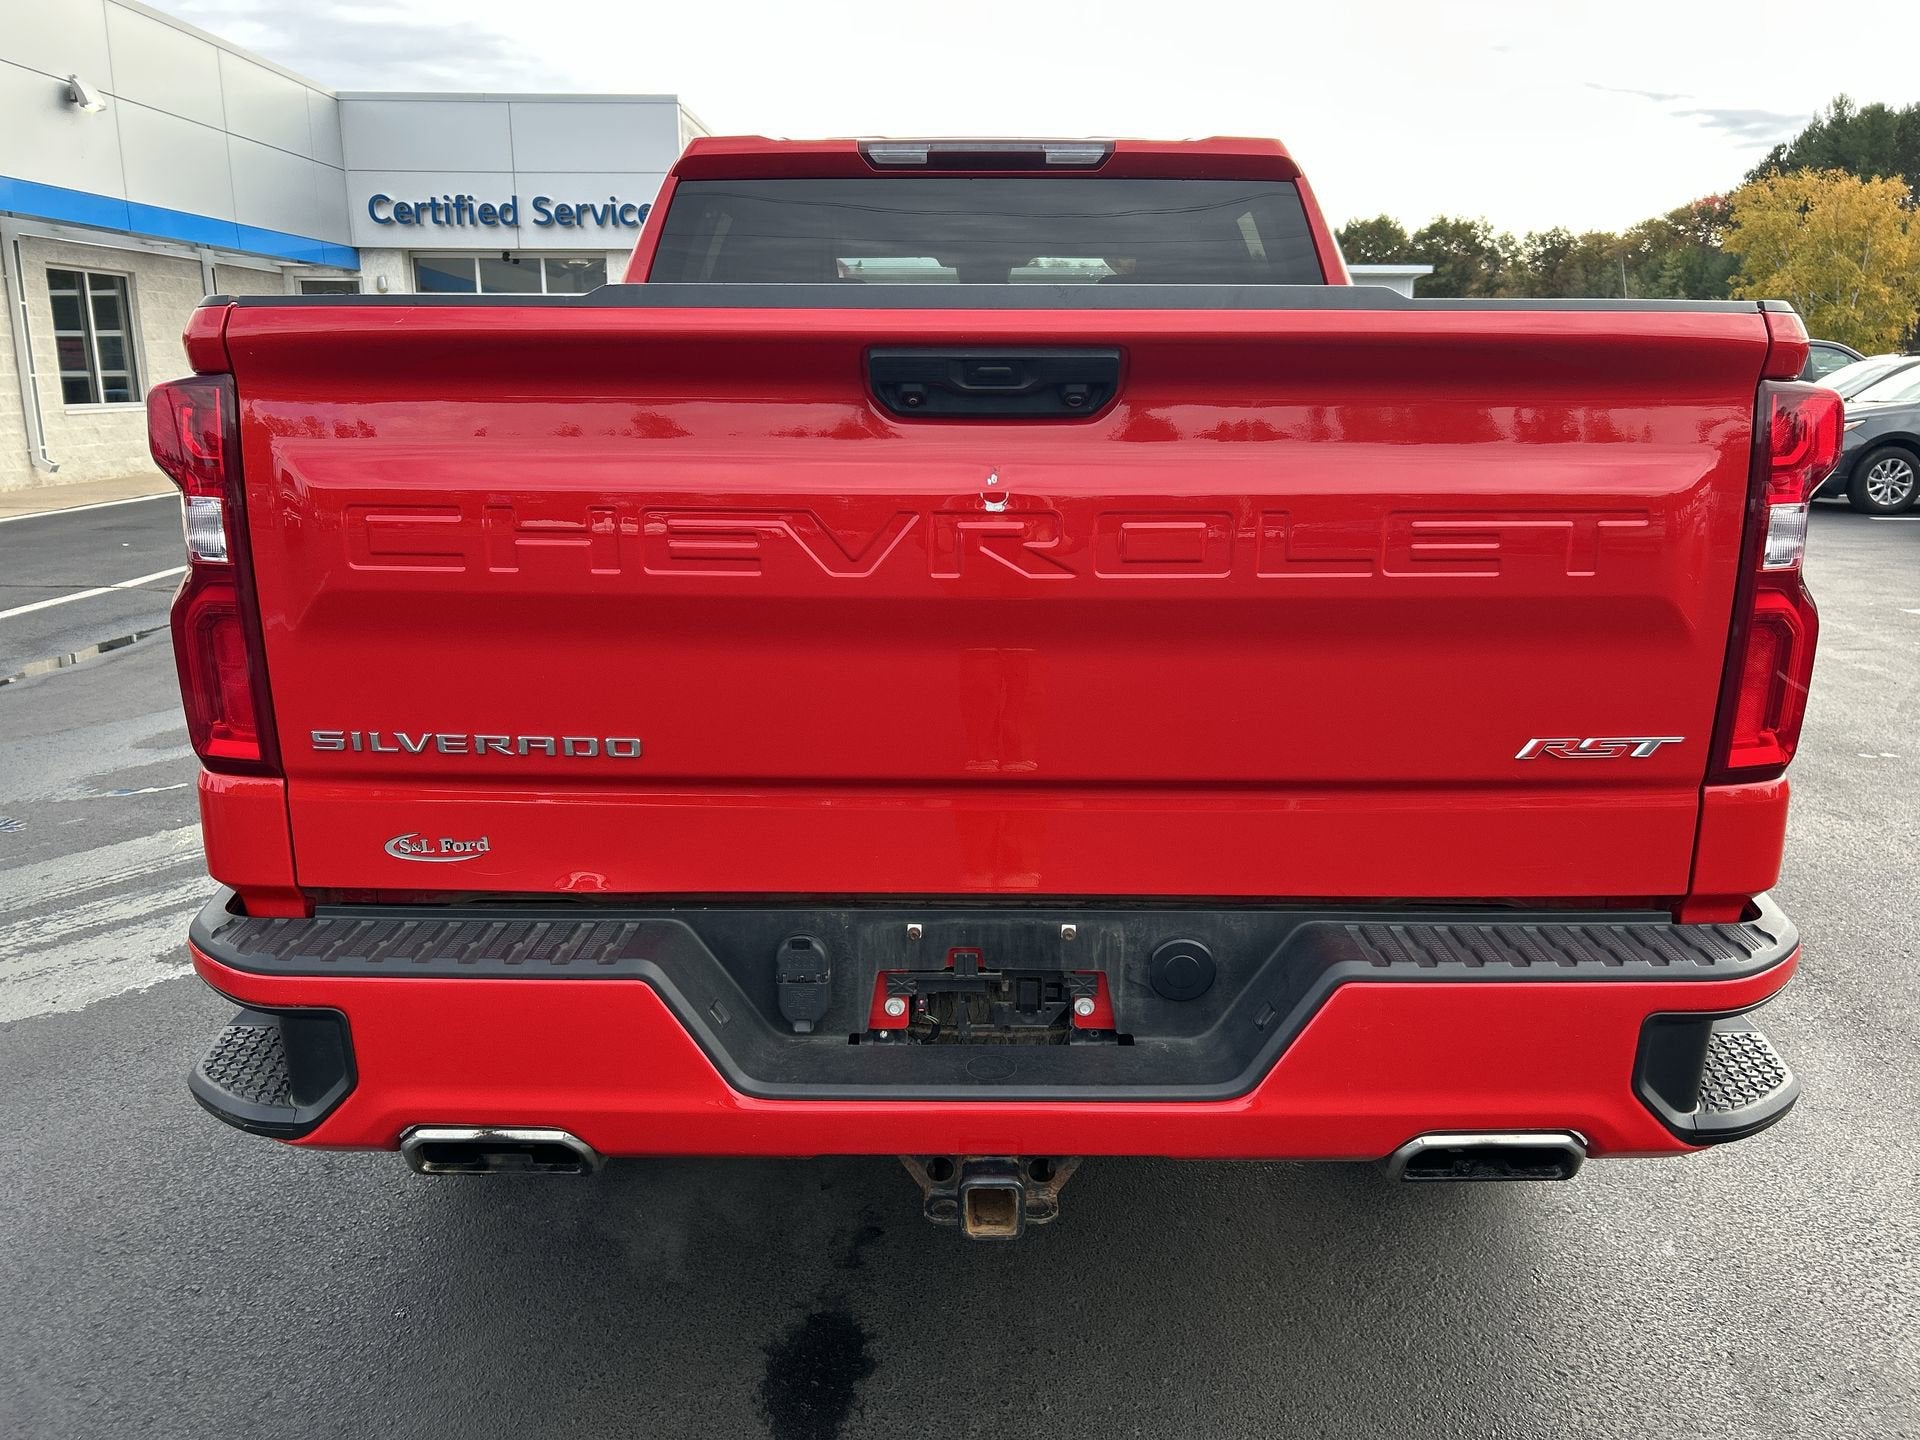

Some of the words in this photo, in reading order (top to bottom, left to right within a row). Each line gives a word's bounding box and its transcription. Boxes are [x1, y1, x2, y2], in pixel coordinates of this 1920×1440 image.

[368, 193, 518, 226] Certified
[345, 503, 1650, 579] CHEVROLET
[310, 730, 642, 758] SILVERADO
[1514, 736, 1685, 759] RST
[399, 838, 435, 854] S&L
[439, 836, 490, 853] Ford
